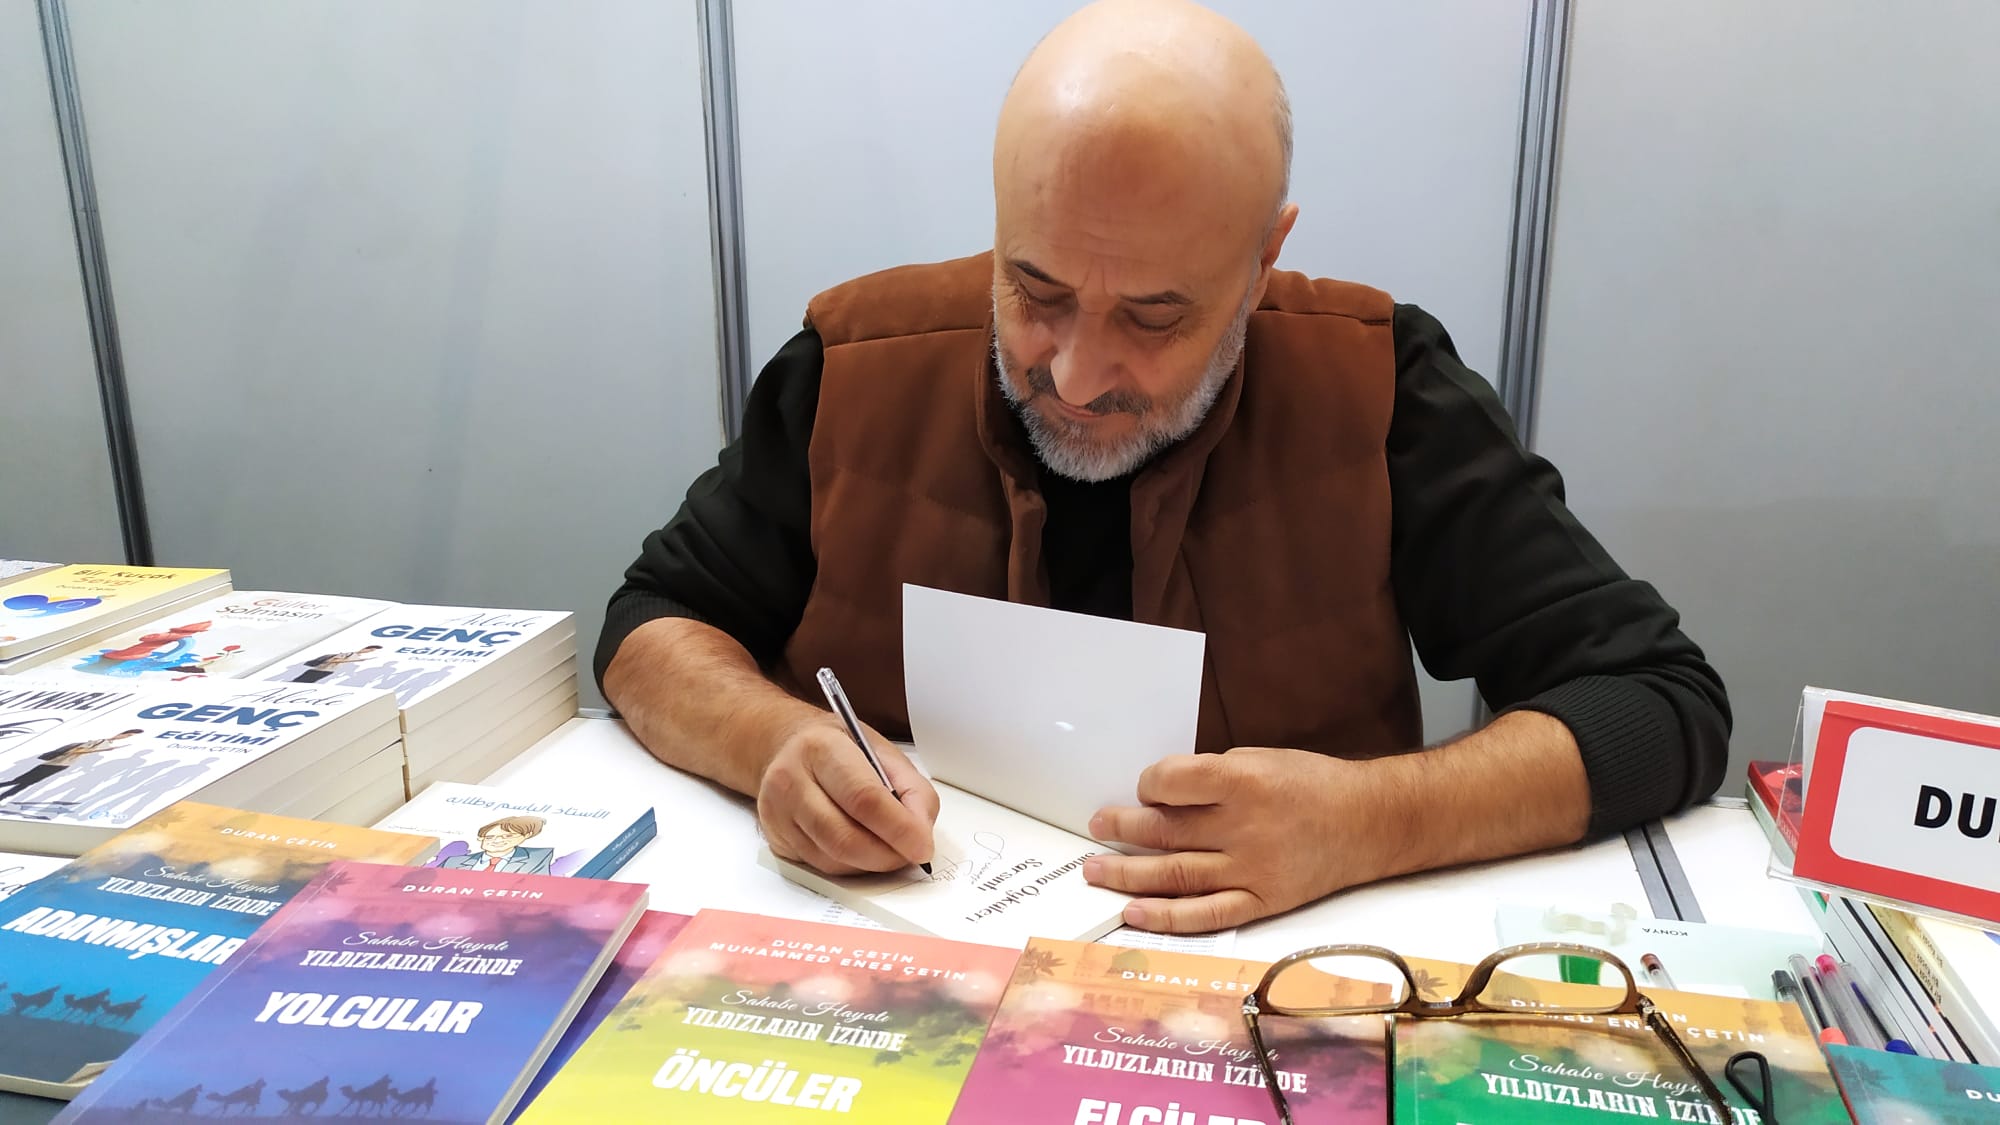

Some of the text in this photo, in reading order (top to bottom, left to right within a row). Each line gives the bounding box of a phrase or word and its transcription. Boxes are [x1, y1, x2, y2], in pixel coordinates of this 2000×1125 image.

[72, 577, 145, 588] Sevgi
[110, 570, 178, 580] Kucak
[216, 605, 324, 620] Solmasın
[253, 598, 330, 610] Güller
[370, 625, 522, 648] GENÇ
[394, 646, 497, 658] EĞİTİMİ
[137, 702, 320, 732] GENÇ
[154, 730, 280, 746] EĞİTİMİ
[1914, 784, 2000, 843] DU
[221, 827, 337, 849] DURAN ÇETİN
[143, 865, 280, 894] Sahabe Hayatı
[977, 857, 1044, 892] Sarsıntı
[97, 876, 283, 916] YILDIZLARIN İZİNDE
[402, 884, 544, 899] DURAN ÇETİN
[965, 885, 1040, 924] Öyküleri
[0, 906, 248, 965] ADANMIŞLAR
[343, 931, 509, 953] Sahabe Hayatı
[1641, 927, 1689, 937] KONYA
[299, 949, 523, 976] YILDIZLARIN İZİNDE
[709, 942, 967, 981] MUHAMMED ENES ÇETİN
[772, 939, 914, 964] DURAN ÇETİN
[1121, 970, 1250, 993] DURAN ÇET
[254, 991, 484, 1034] YOLCULAR
[721, 989, 890, 1023] Sahabe Hayatı
[681, 1005, 907, 1052] YILDIZLARIN İZİNDE
[1686, 1026, 1766, 1044] ÇETİN
[1094, 1027, 1281, 1063] Sahabe Haytı
[1063, 1044, 1214, 1083] YILDIZLARIN
[1508, 1054, 1605, 1081] Sahabe
[652, 1047, 862, 1113] ÖNCÜLER
[1481, 1072, 1659, 1119] YILDIZLARIN
